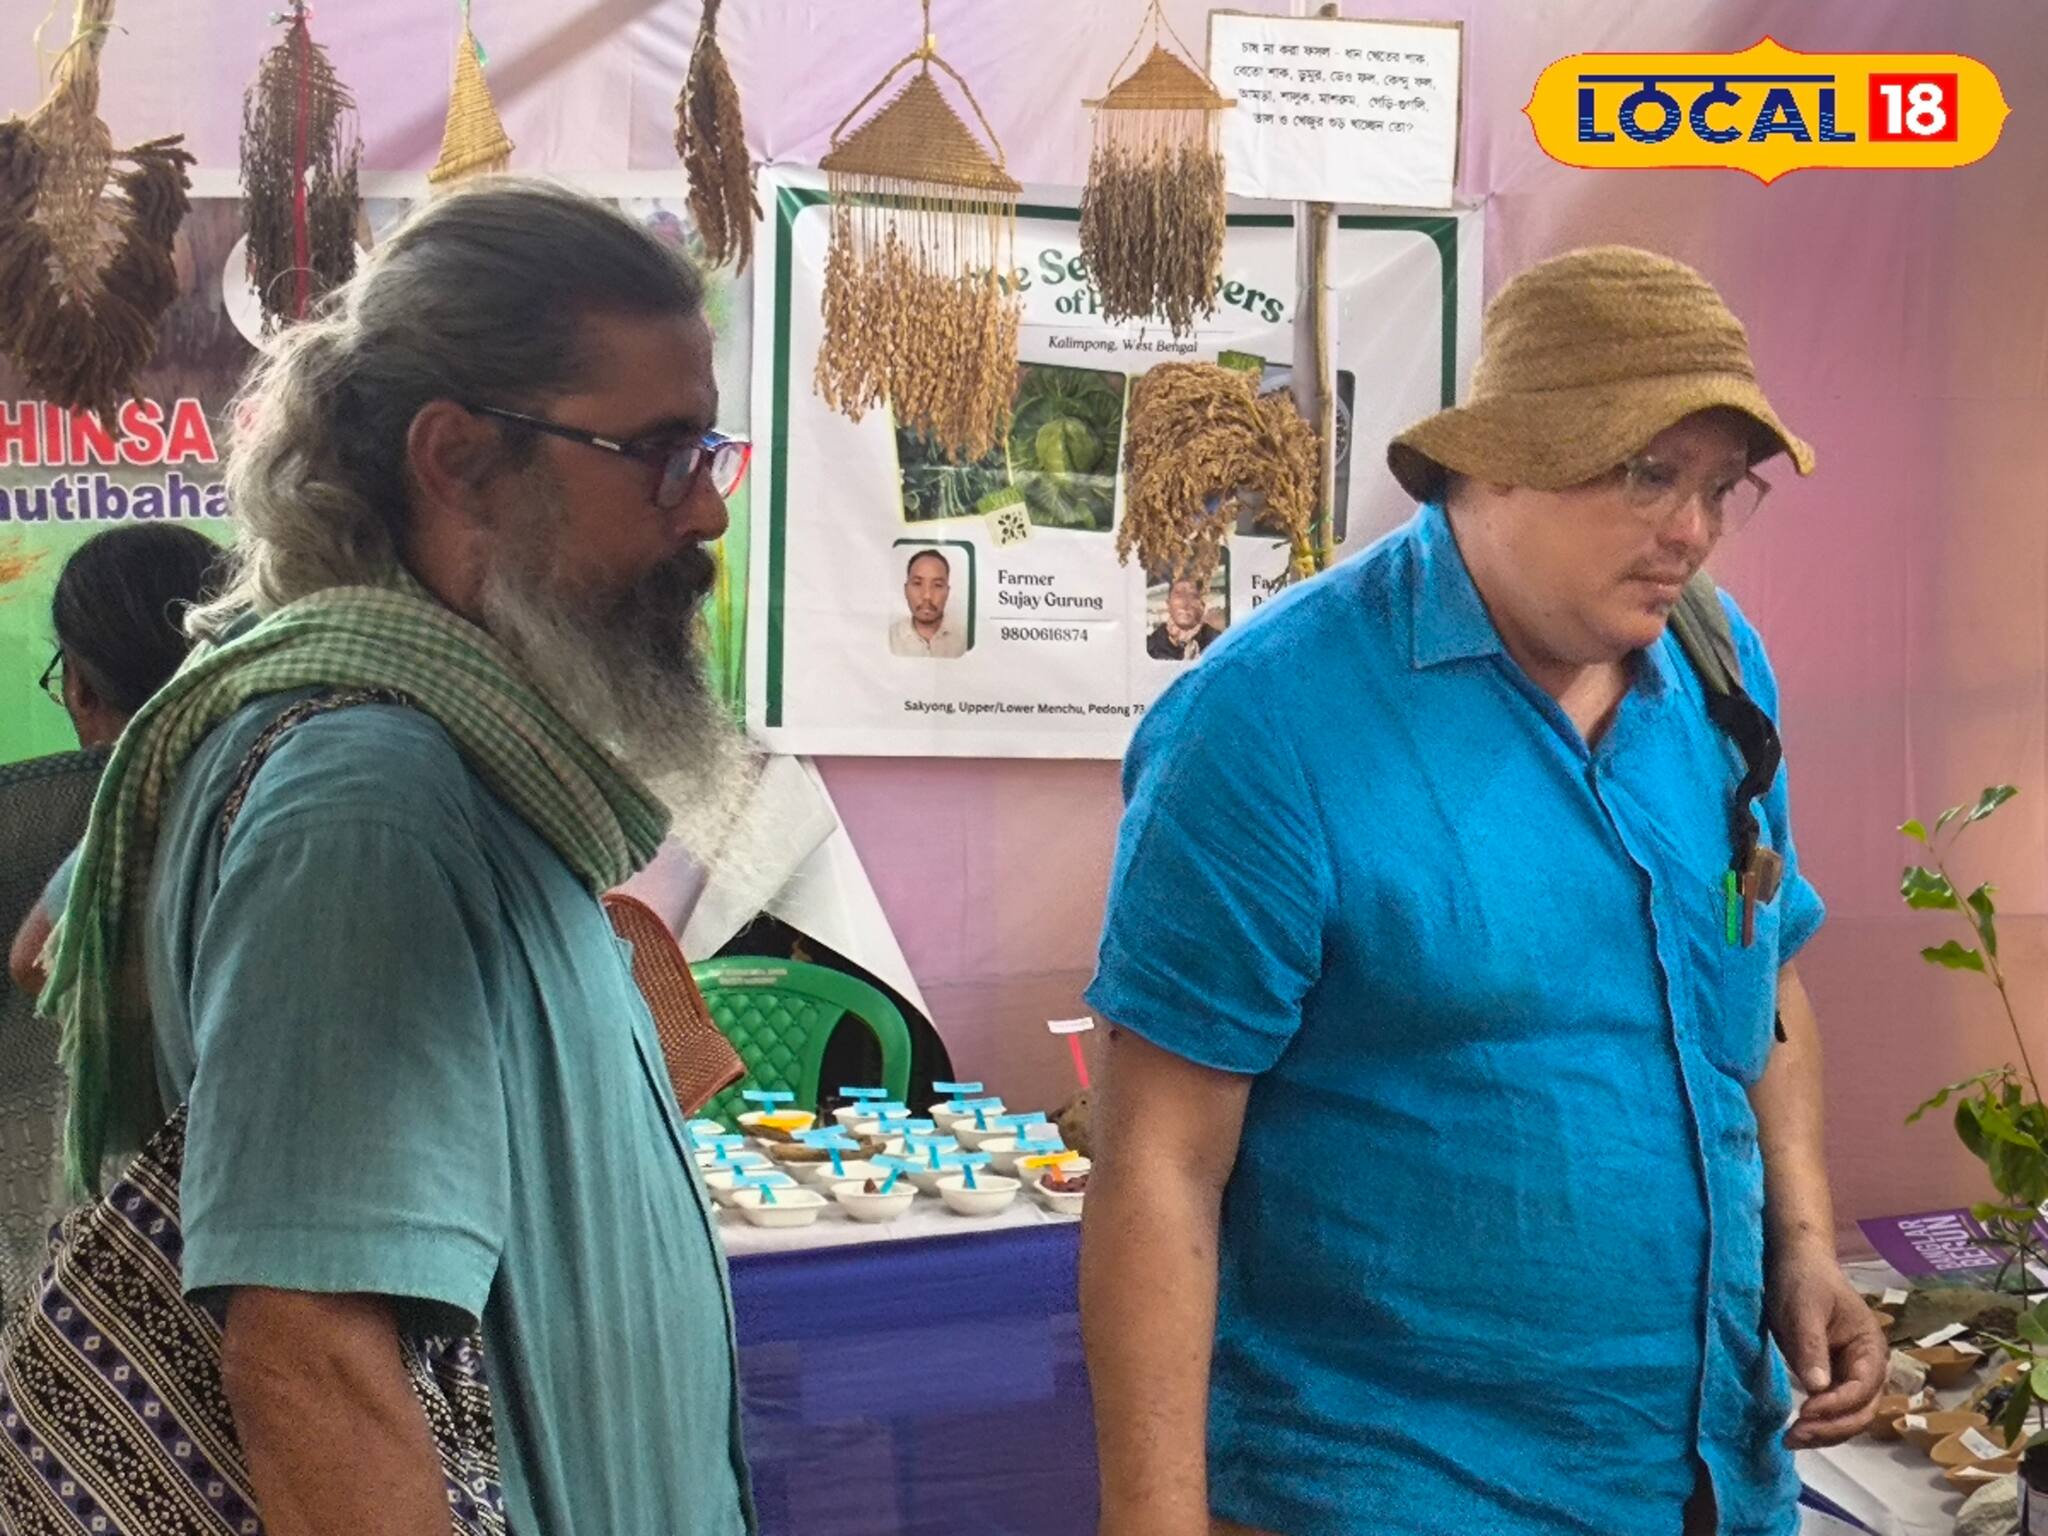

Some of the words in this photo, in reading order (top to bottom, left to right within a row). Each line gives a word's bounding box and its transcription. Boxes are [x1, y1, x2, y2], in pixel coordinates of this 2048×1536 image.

[1262, 43, 1274, 55] না
[1279, 45, 1299, 56] করা
[1303, 46, 1331, 57] ফসল
[1055, 288, 1086, 315] of
[1048, 335, 1118, 353] Kalimpong,
[998, 570, 1055, 586] Farmer
[998, 590, 1041, 608] Sujay
[1044, 592, 1104, 609] Gurung
[904, 701, 955, 714] Sakyong,
[959, 702, 1034, 715] Upper/Lower
[1037, 704, 1086, 715] Menchu,
[1088, 704, 1130, 717] Pedong
[1921, 1214, 1997, 1267] BEGUN
